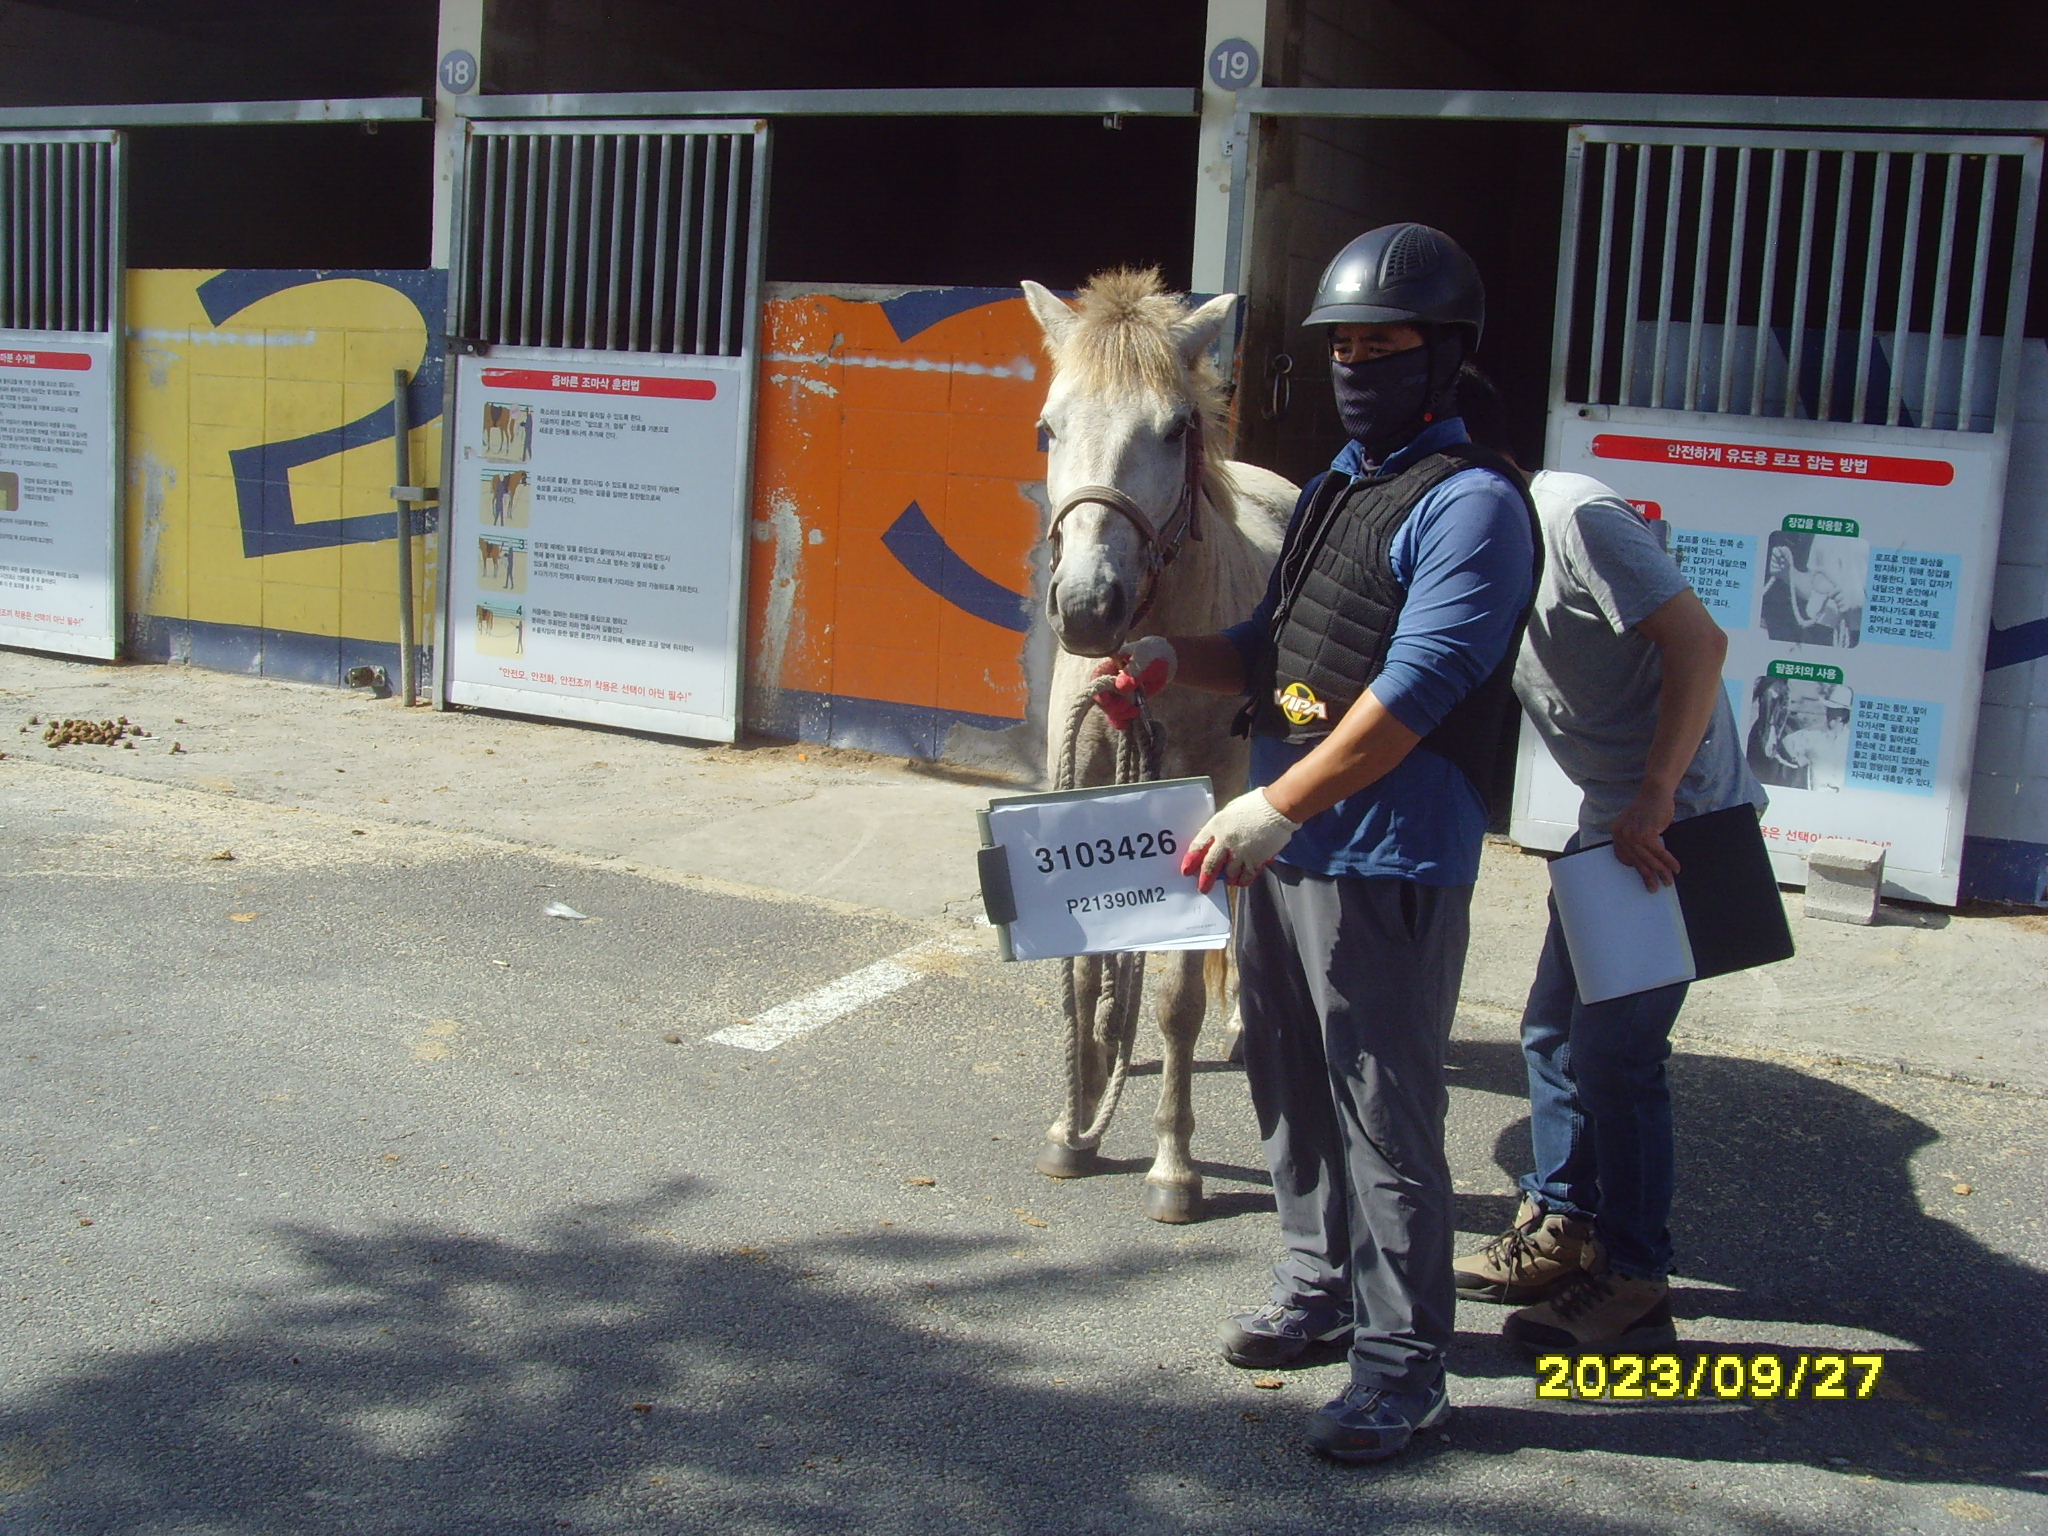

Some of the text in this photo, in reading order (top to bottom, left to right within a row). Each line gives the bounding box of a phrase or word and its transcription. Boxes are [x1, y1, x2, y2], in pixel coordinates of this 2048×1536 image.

[445, 60, 469, 84] 18
[1217, 51, 1249, 79] 19
[552, 374, 640, 392] 올바른 조마삭 훈련법
[1666, 444, 1868, 474] 안전하게 유도용 로프 잡는 방법
[1788, 518, 1855, 534] 장갑을 착용할 것
[518, 539, 524, 550] 3
[516, 605, 522, 616] 4
[1775, 662, 1837, 680] 팔꿈치의 사용
[531, 671, 556, 685] 안전화,
[560, 676, 592, 689] 안전조끼
[595, 680, 618, 694] 착용은
[622, 684, 646, 697] 선택이
[648, 688, 665, 701] 아닌
[1274, 688, 1328, 720] VIPA
[1035, 829, 1177, 873] 3103426
[1066, 886, 1167, 914] P21390M2
